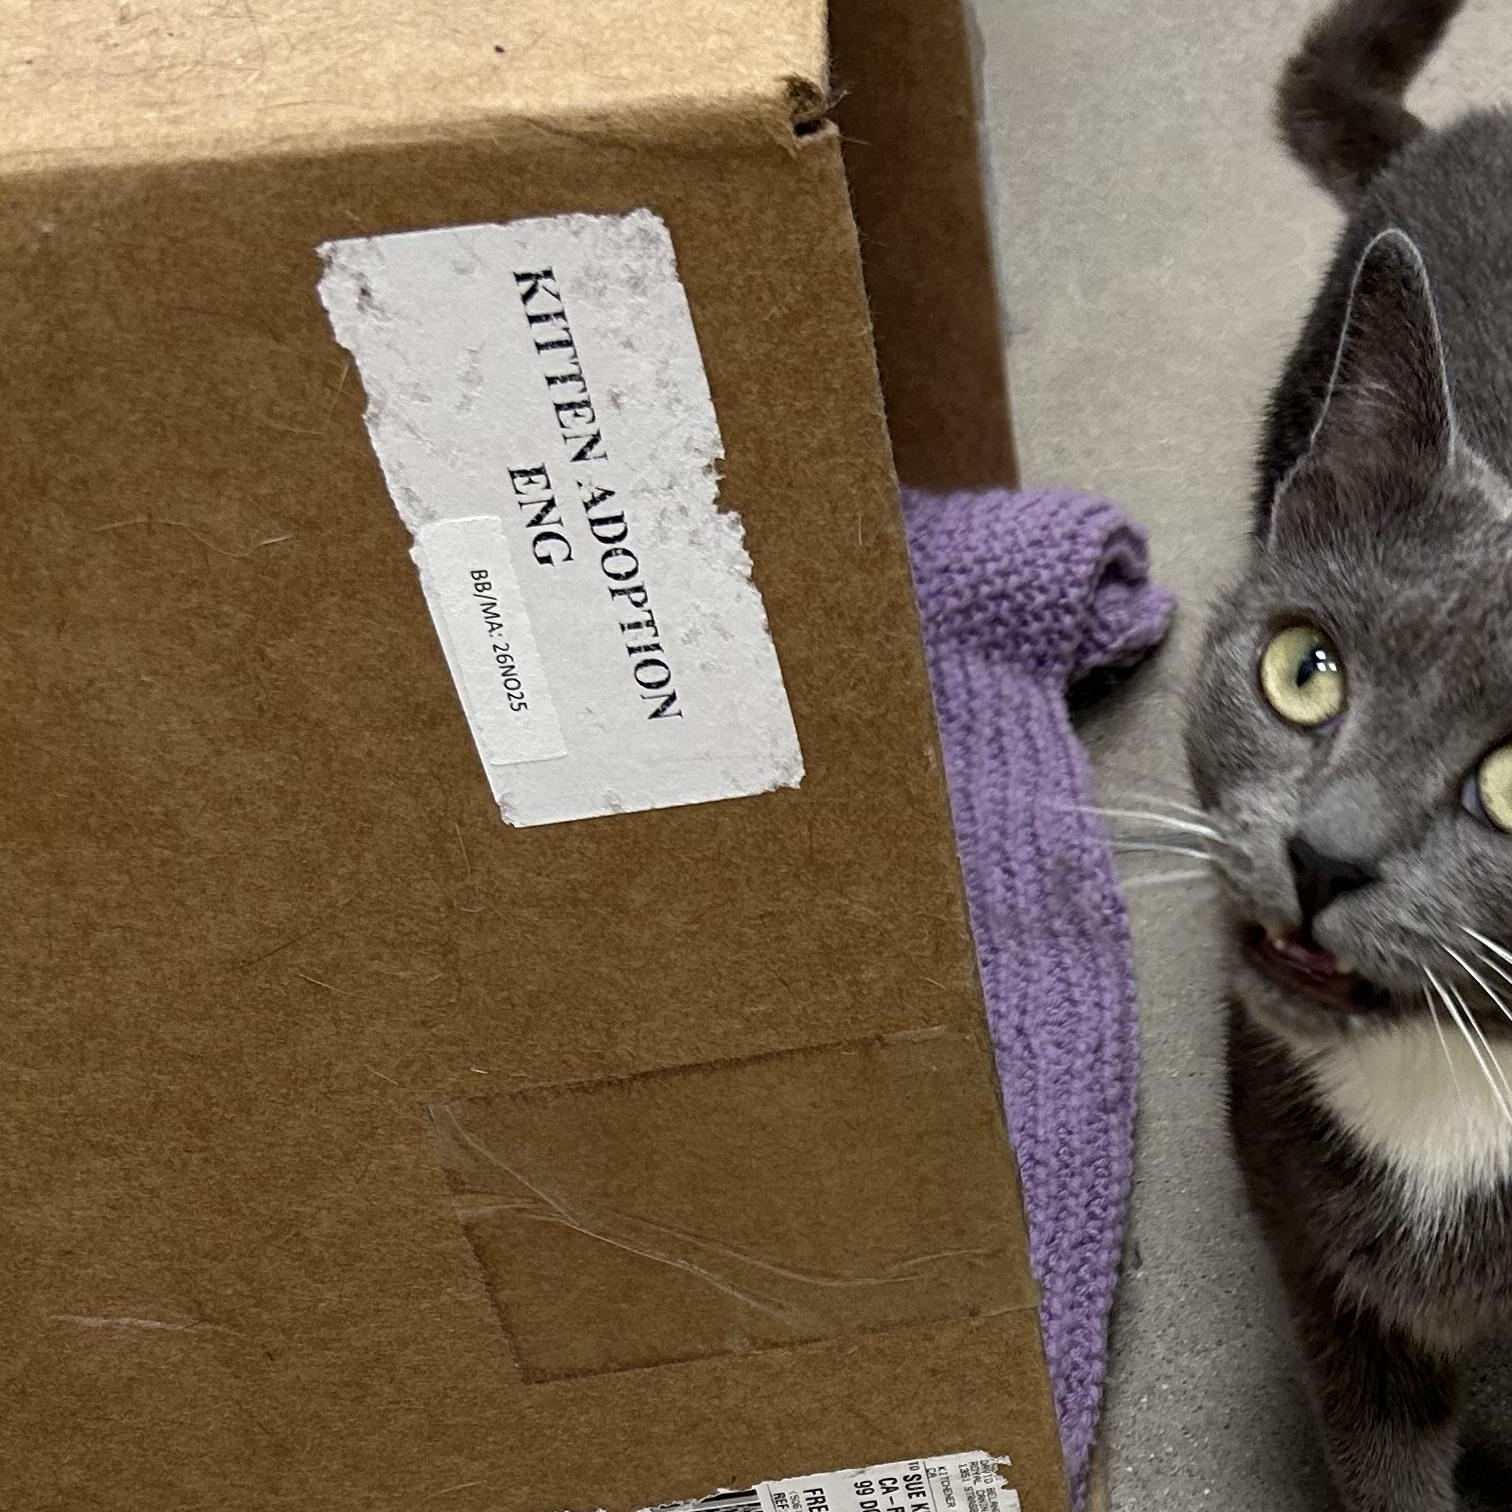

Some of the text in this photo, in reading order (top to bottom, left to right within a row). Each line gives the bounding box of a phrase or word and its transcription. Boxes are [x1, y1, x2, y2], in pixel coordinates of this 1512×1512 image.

[507, 464, 572, 565] ENG
[513, 268, 681, 719] KITTEN ADOPTION
[469, 567, 506, 640] BB/MA:
[852, 1479, 875, 1496] 99
[901, 1472, 927, 1499] SUE
[906, 1460, 920, 1472] TO
